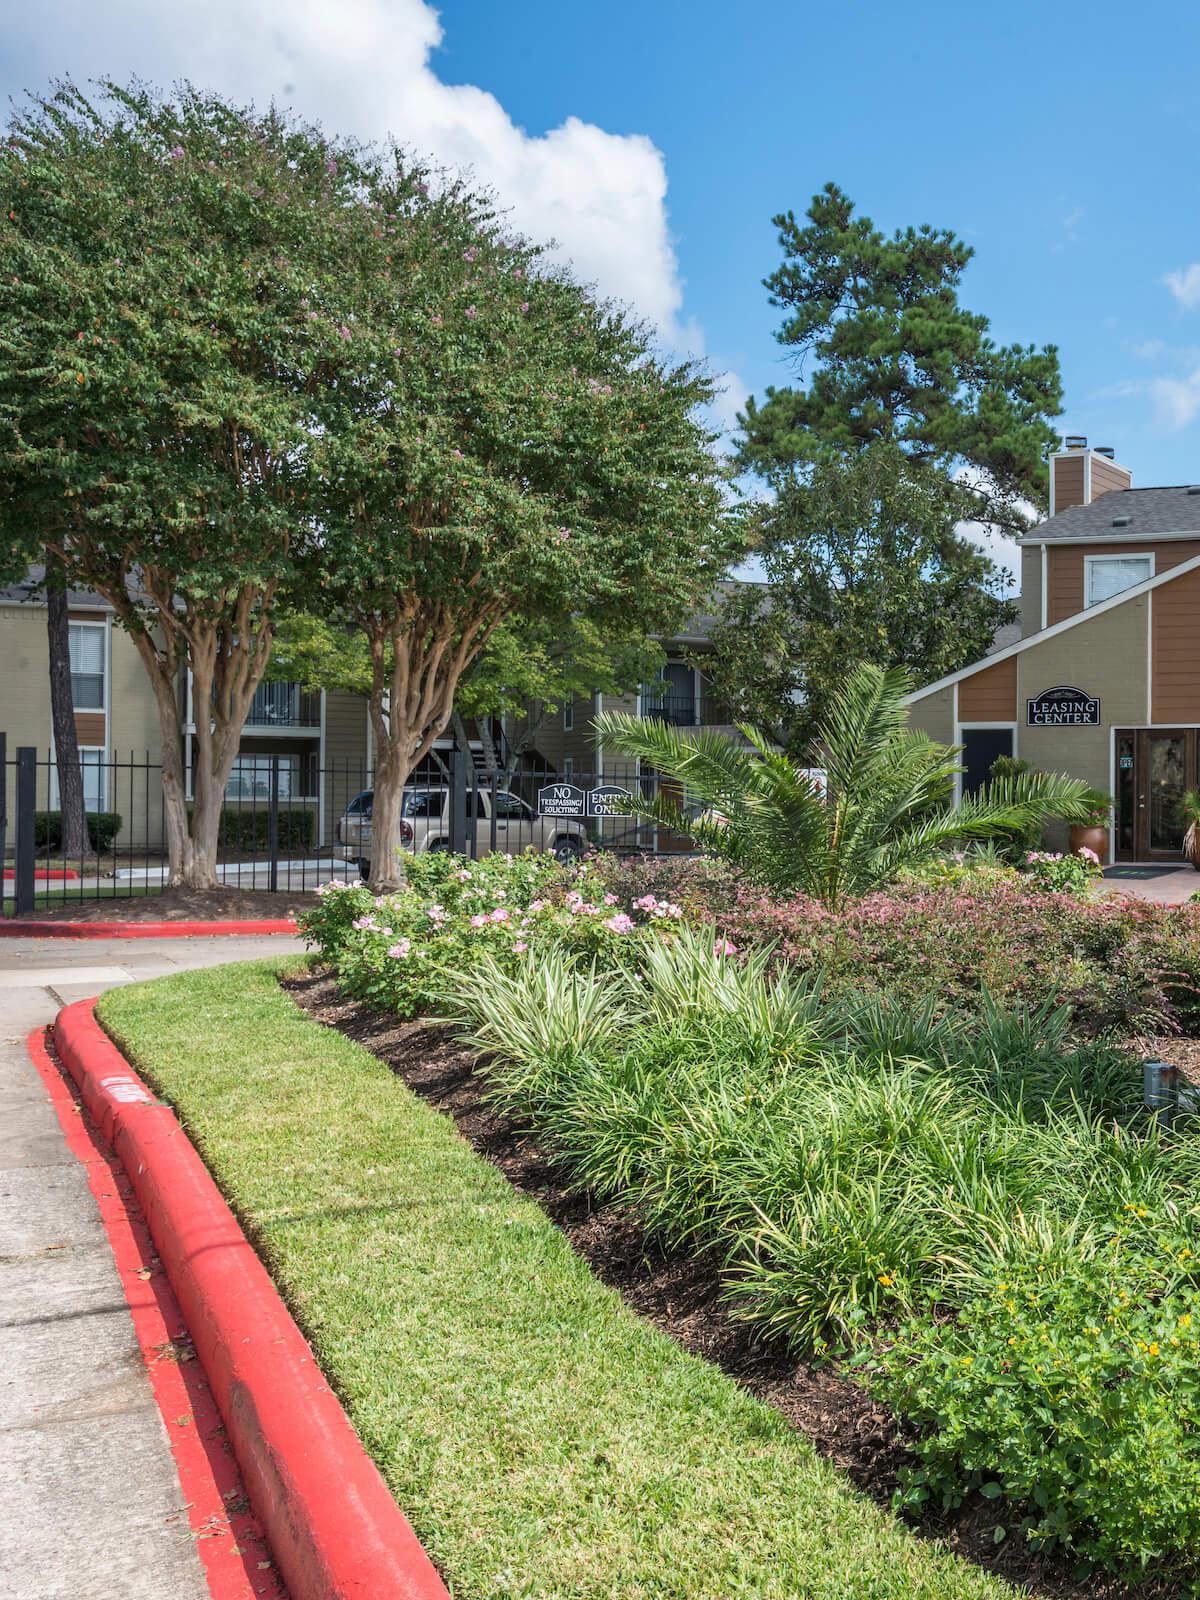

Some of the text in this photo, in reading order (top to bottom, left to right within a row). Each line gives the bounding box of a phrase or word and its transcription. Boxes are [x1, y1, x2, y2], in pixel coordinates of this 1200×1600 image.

[1033, 702, 1095, 713] LEASING
[1034, 713, 1092, 723] CENTER
[553, 787, 571, 799] NO
[544, 806, 579, 814] SOLICITING
